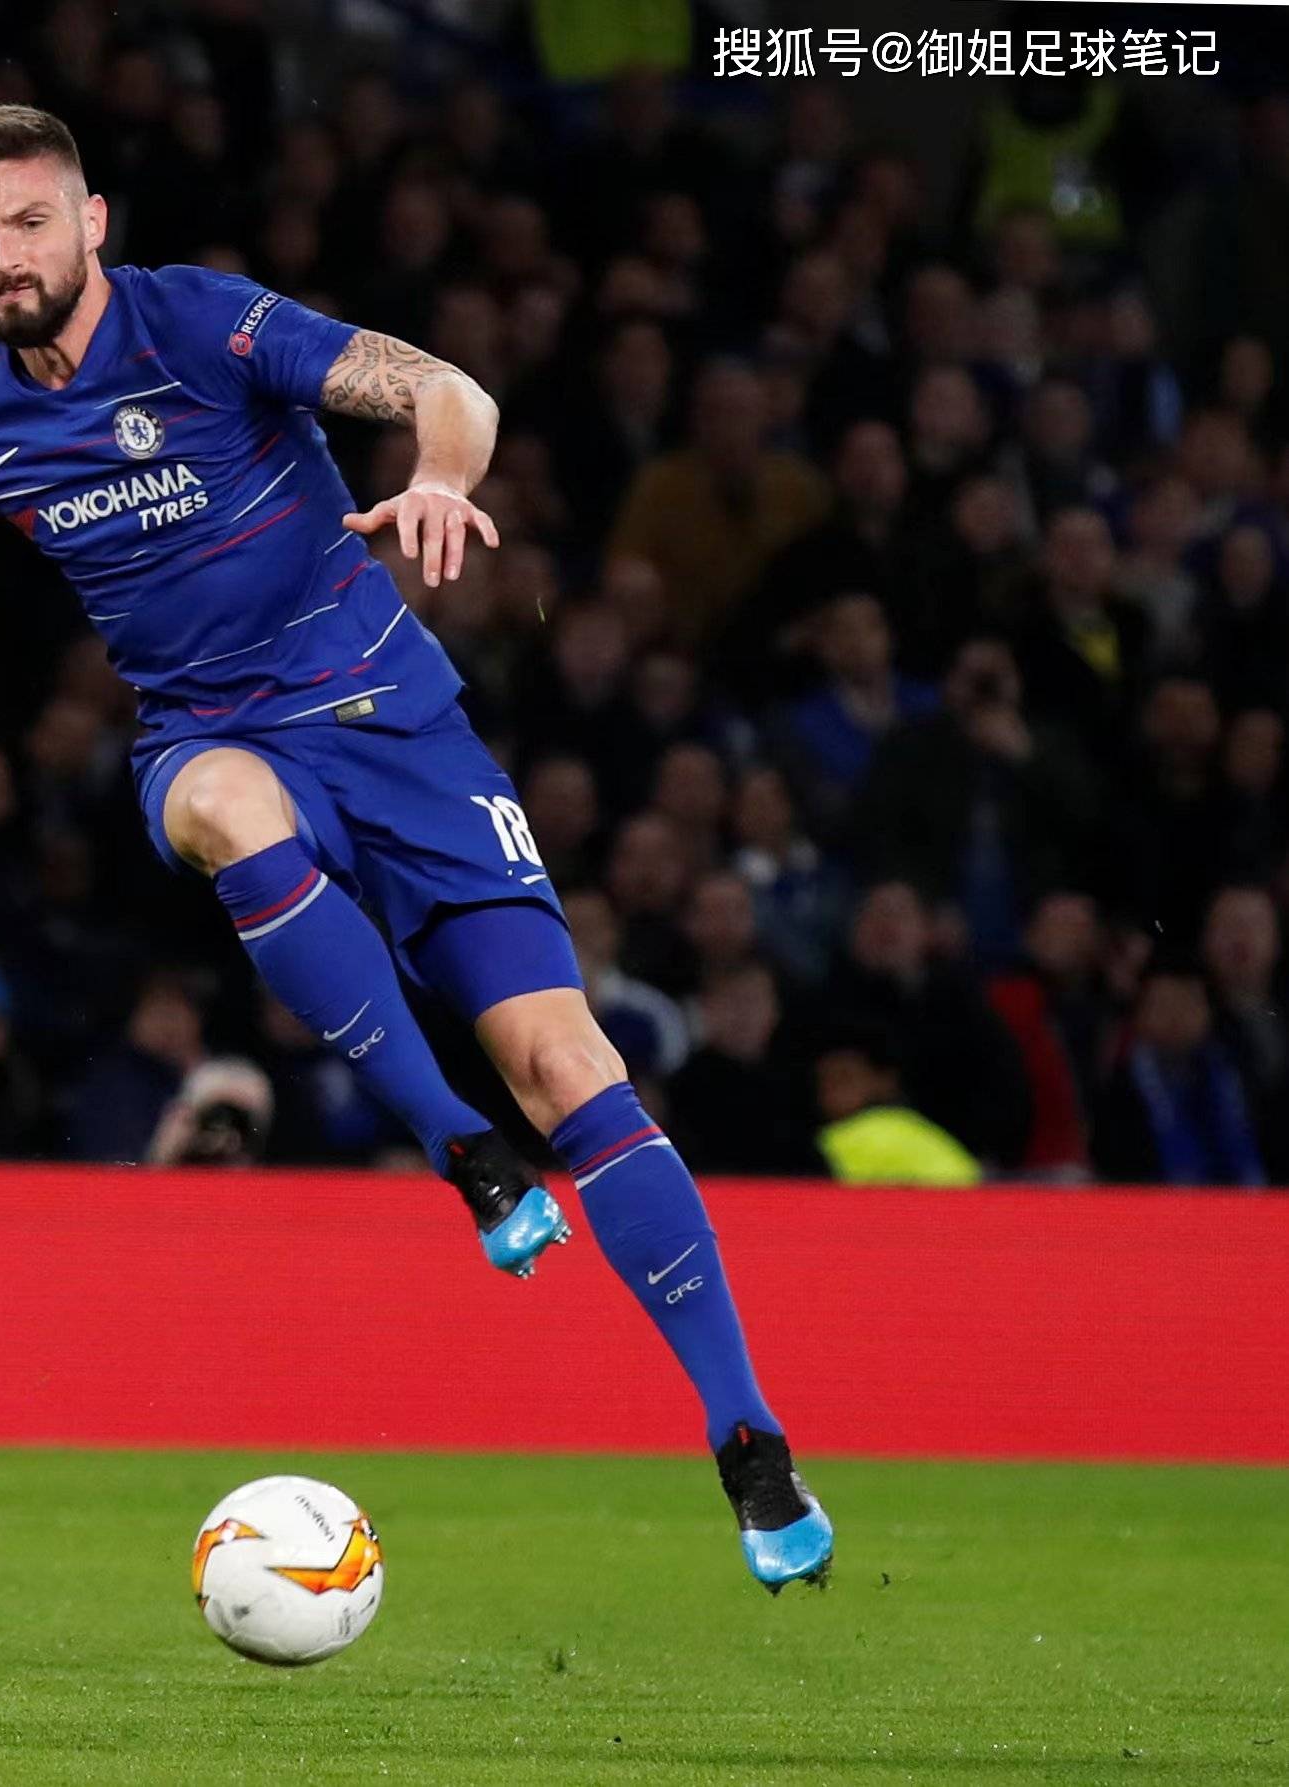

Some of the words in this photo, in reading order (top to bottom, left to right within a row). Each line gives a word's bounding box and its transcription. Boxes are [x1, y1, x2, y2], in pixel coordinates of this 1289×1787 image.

[38, 463, 203, 534] YOKOHAMA
[138, 490, 209, 531] TYRES
[470, 795, 543, 867] 18
[349, 1027, 385, 1058] CFC
[666, 1275, 703, 1304] CFC
